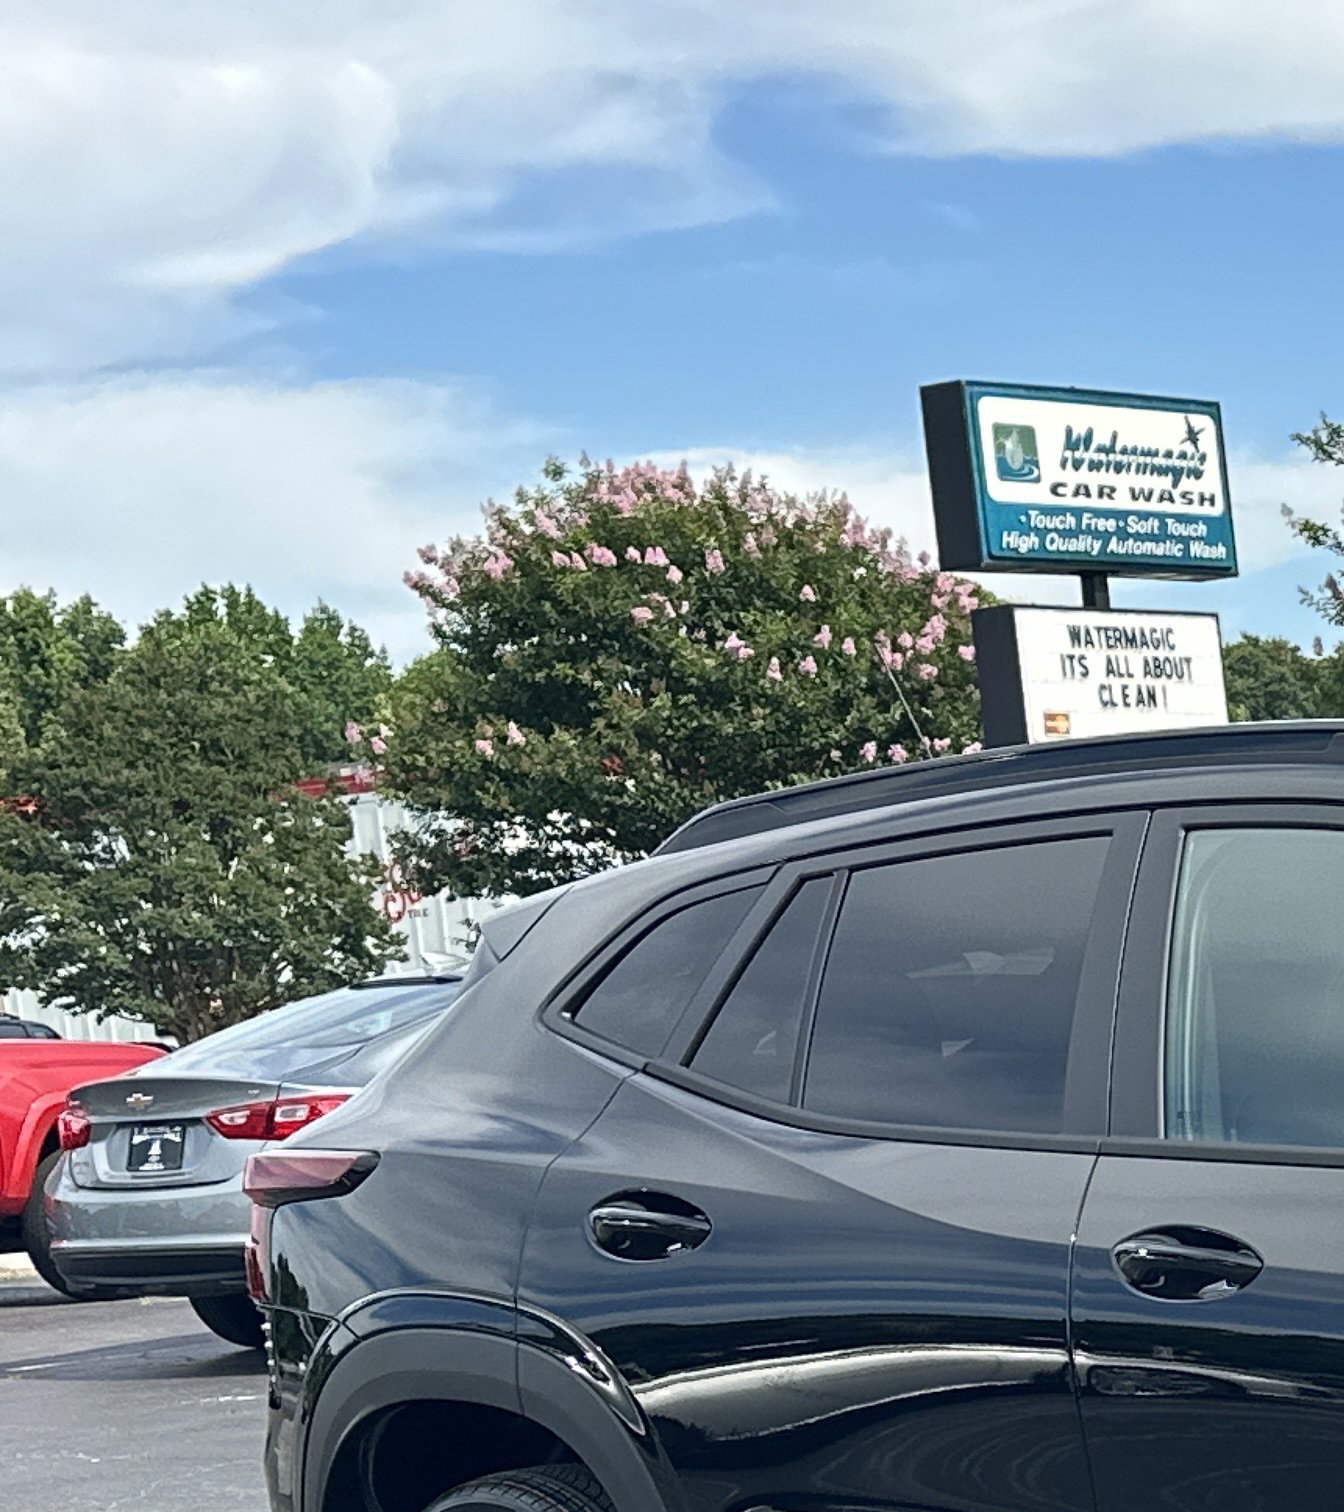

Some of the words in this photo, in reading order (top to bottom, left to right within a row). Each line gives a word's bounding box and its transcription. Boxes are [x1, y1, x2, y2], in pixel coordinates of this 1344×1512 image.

[1060, 424, 1207, 490] Watermagic
[1049, 481, 1118, 501] CAR
[1128, 486, 1216, 508] WASH
[1027, 510, 1076, 529] Touch
[1165, 518, 1208, 538] Touch
[1002, 530, 1039, 553] High
[1045, 531, 1103, 556] Quality
[1107, 535, 1184, 557] Automatic
[1189, 540, 1227, 560] Wash
[1066, 624, 1176, 650] WATERMAGIC
[1060, 653, 1090, 680] ITS
[1105, 654, 1135, 679] ALL
[1143, 655, 1194, 684] ABOUT
